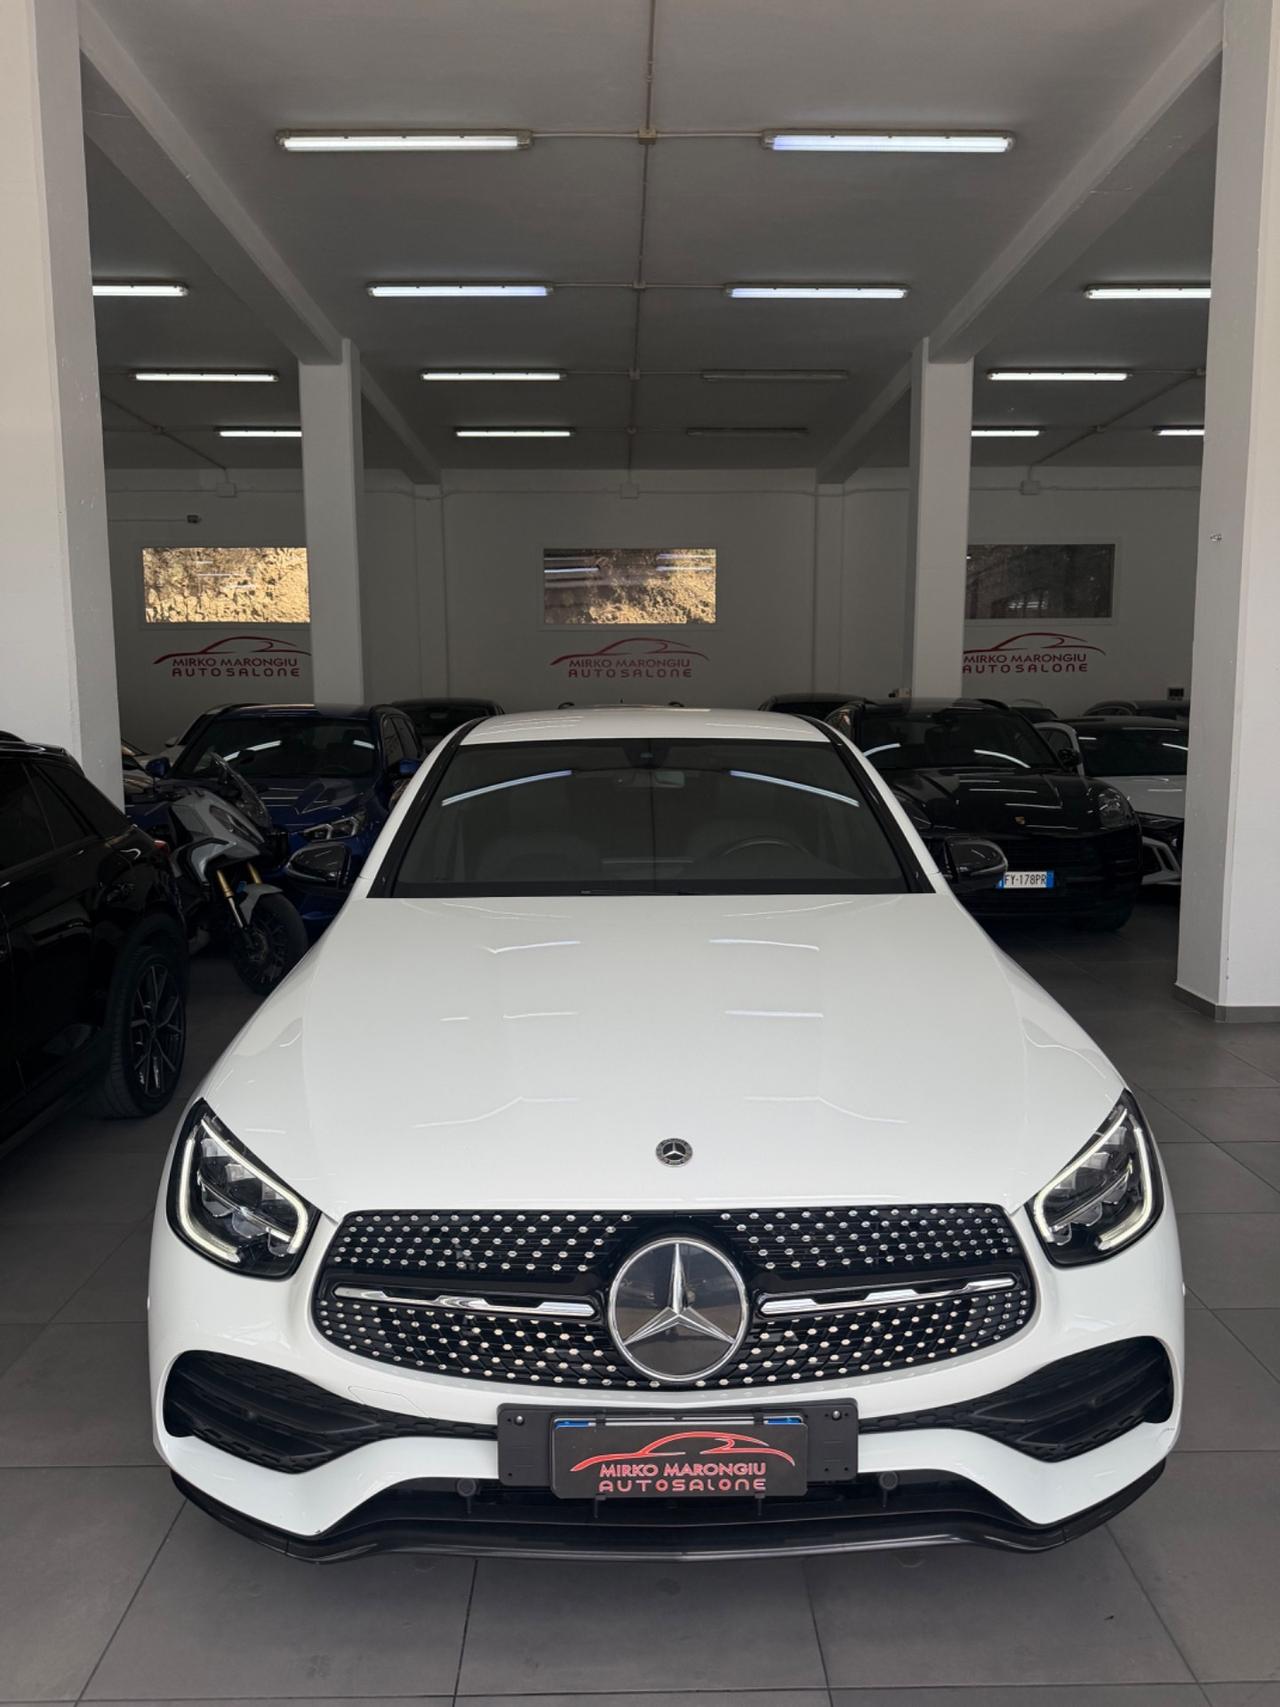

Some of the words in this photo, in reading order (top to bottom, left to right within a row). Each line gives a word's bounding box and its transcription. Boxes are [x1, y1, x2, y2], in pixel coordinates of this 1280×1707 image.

[172, 658, 216, 667] MIRKO
[220, 658, 297, 667] MARONGIU
[569, 659, 612, 668] MIRKO
[615, 658, 690, 668] MARONGIU
[963, 655, 1007, 664] MIRKO
[1011, 653, 1087, 663] MARONGIU
[172, 667, 300, 677] AUTOSALONE
[568, 668, 692, 678] AUTOSALONE
[962, 663, 1088, 674] AUTOSALONE
[600, 1463, 659, 1477] MIRKO
[664, 1462, 766, 1477] MARONGIU
[599, 1478, 767, 1493] AUTOSALONE
